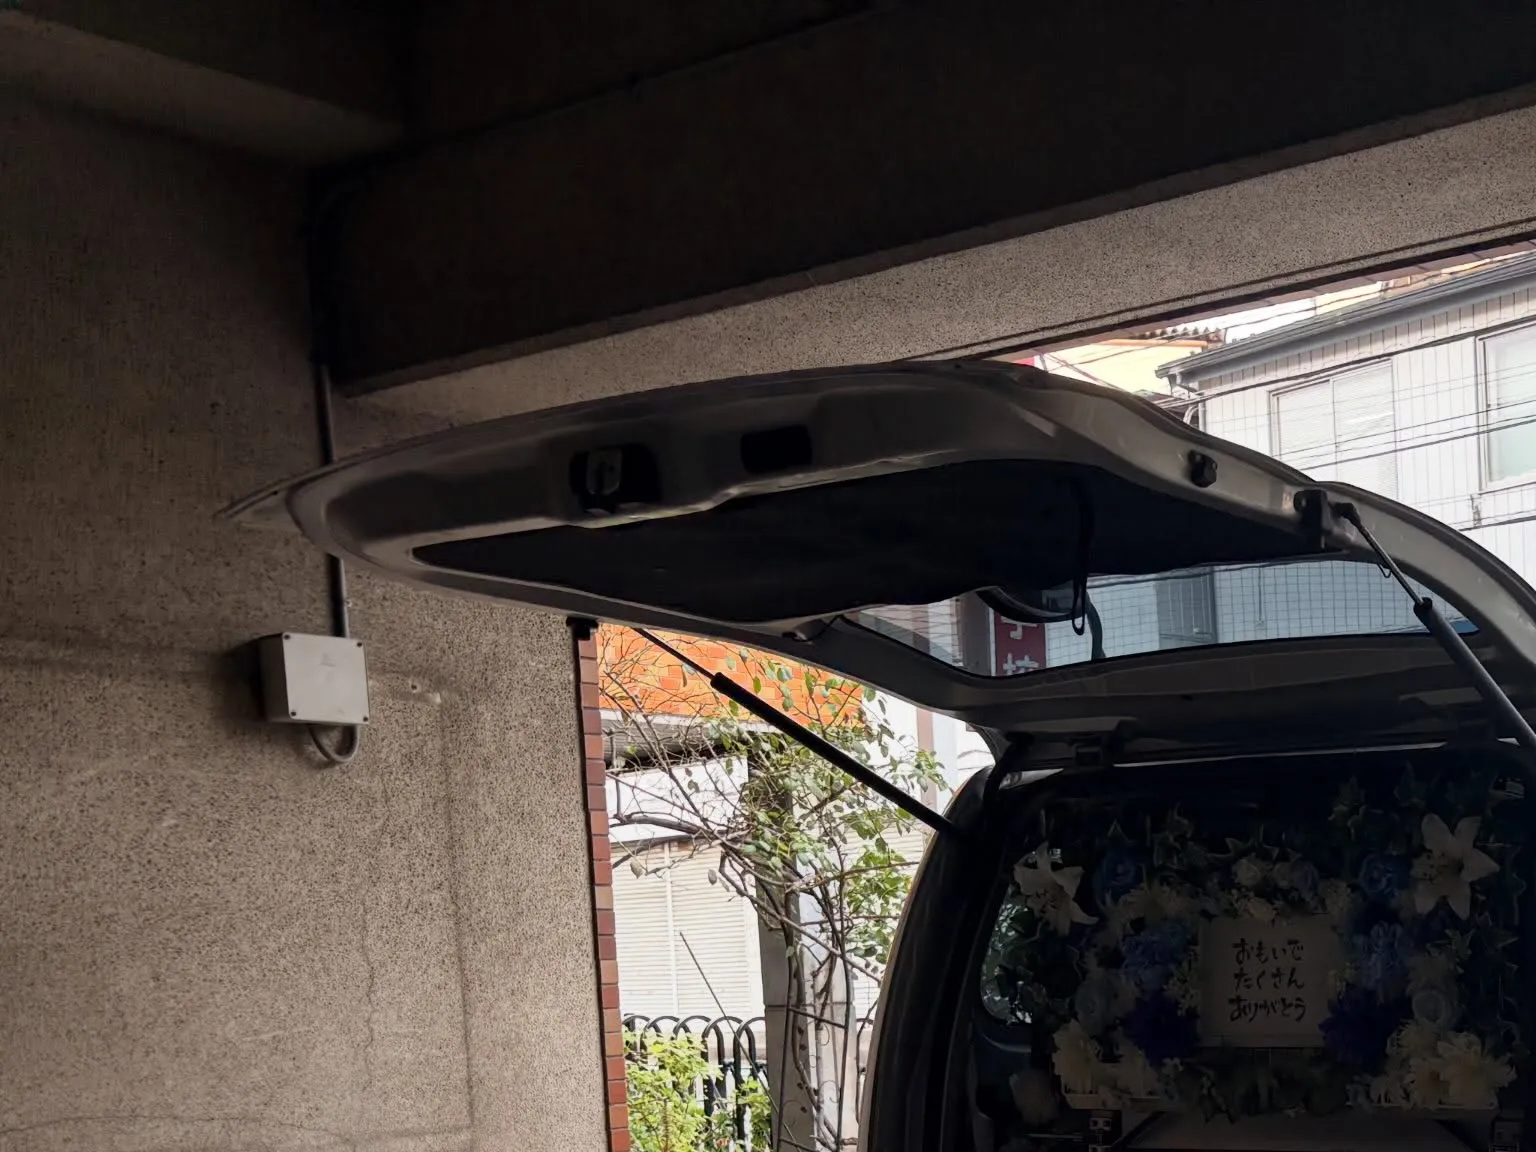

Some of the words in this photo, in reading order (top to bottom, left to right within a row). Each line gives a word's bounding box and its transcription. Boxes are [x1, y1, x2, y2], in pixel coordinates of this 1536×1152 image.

[1232, 937, 1305, 965] おもいで
[1233, 967, 1305, 991] たくさん
[1228, 995, 1307, 1023] ありがとう
